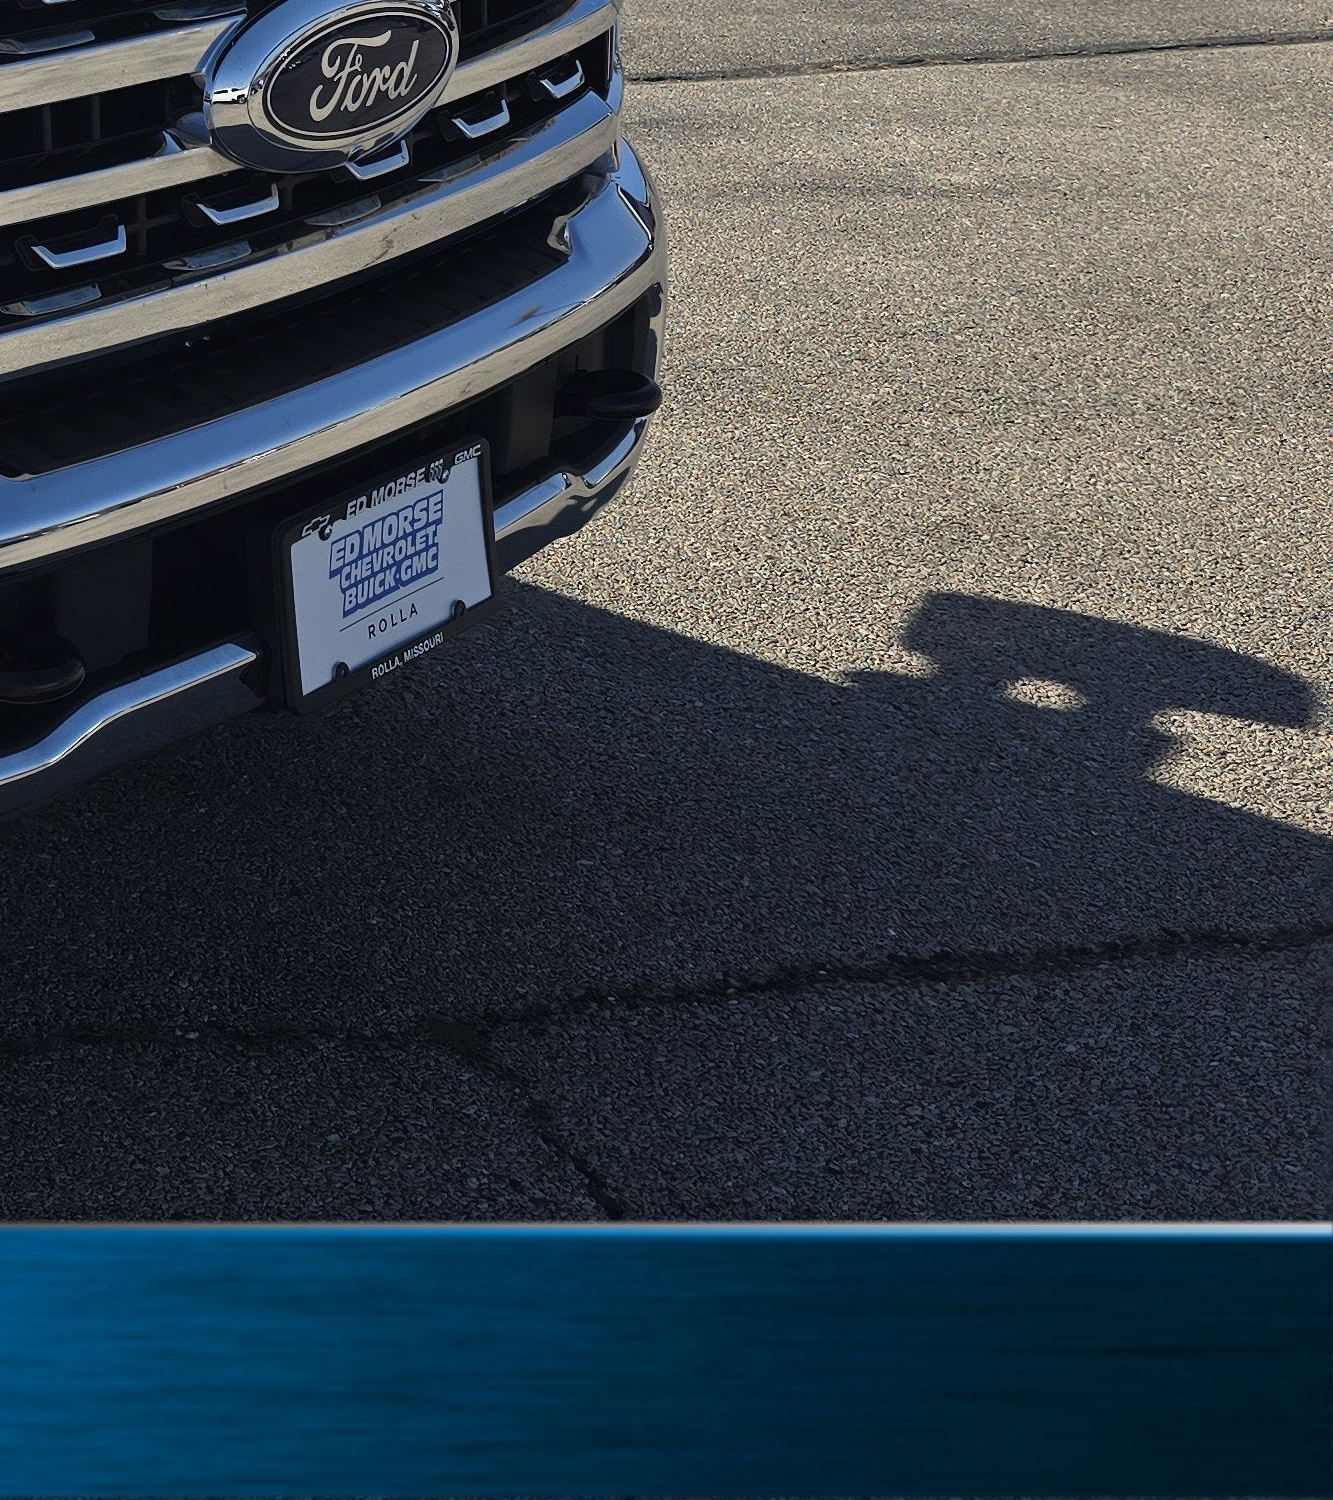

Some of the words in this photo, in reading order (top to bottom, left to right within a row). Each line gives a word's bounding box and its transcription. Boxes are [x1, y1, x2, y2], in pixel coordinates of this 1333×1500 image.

[309, 29, 420, 122] Ford
[454, 444, 482, 466] GMC
[346, 500, 367, 521] ED
[371, 467, 426, 508] MORSE
[329, 531, 362, 573] ED
[363, 492, 444, 553] MORSE
[340, 523, 439, 590] CHEVROLET
[367, 602, 418, 640] ROLLA
[371, 656, 403, 680] ROLLA,
[403, 631, 444, 664] MISSOURI
